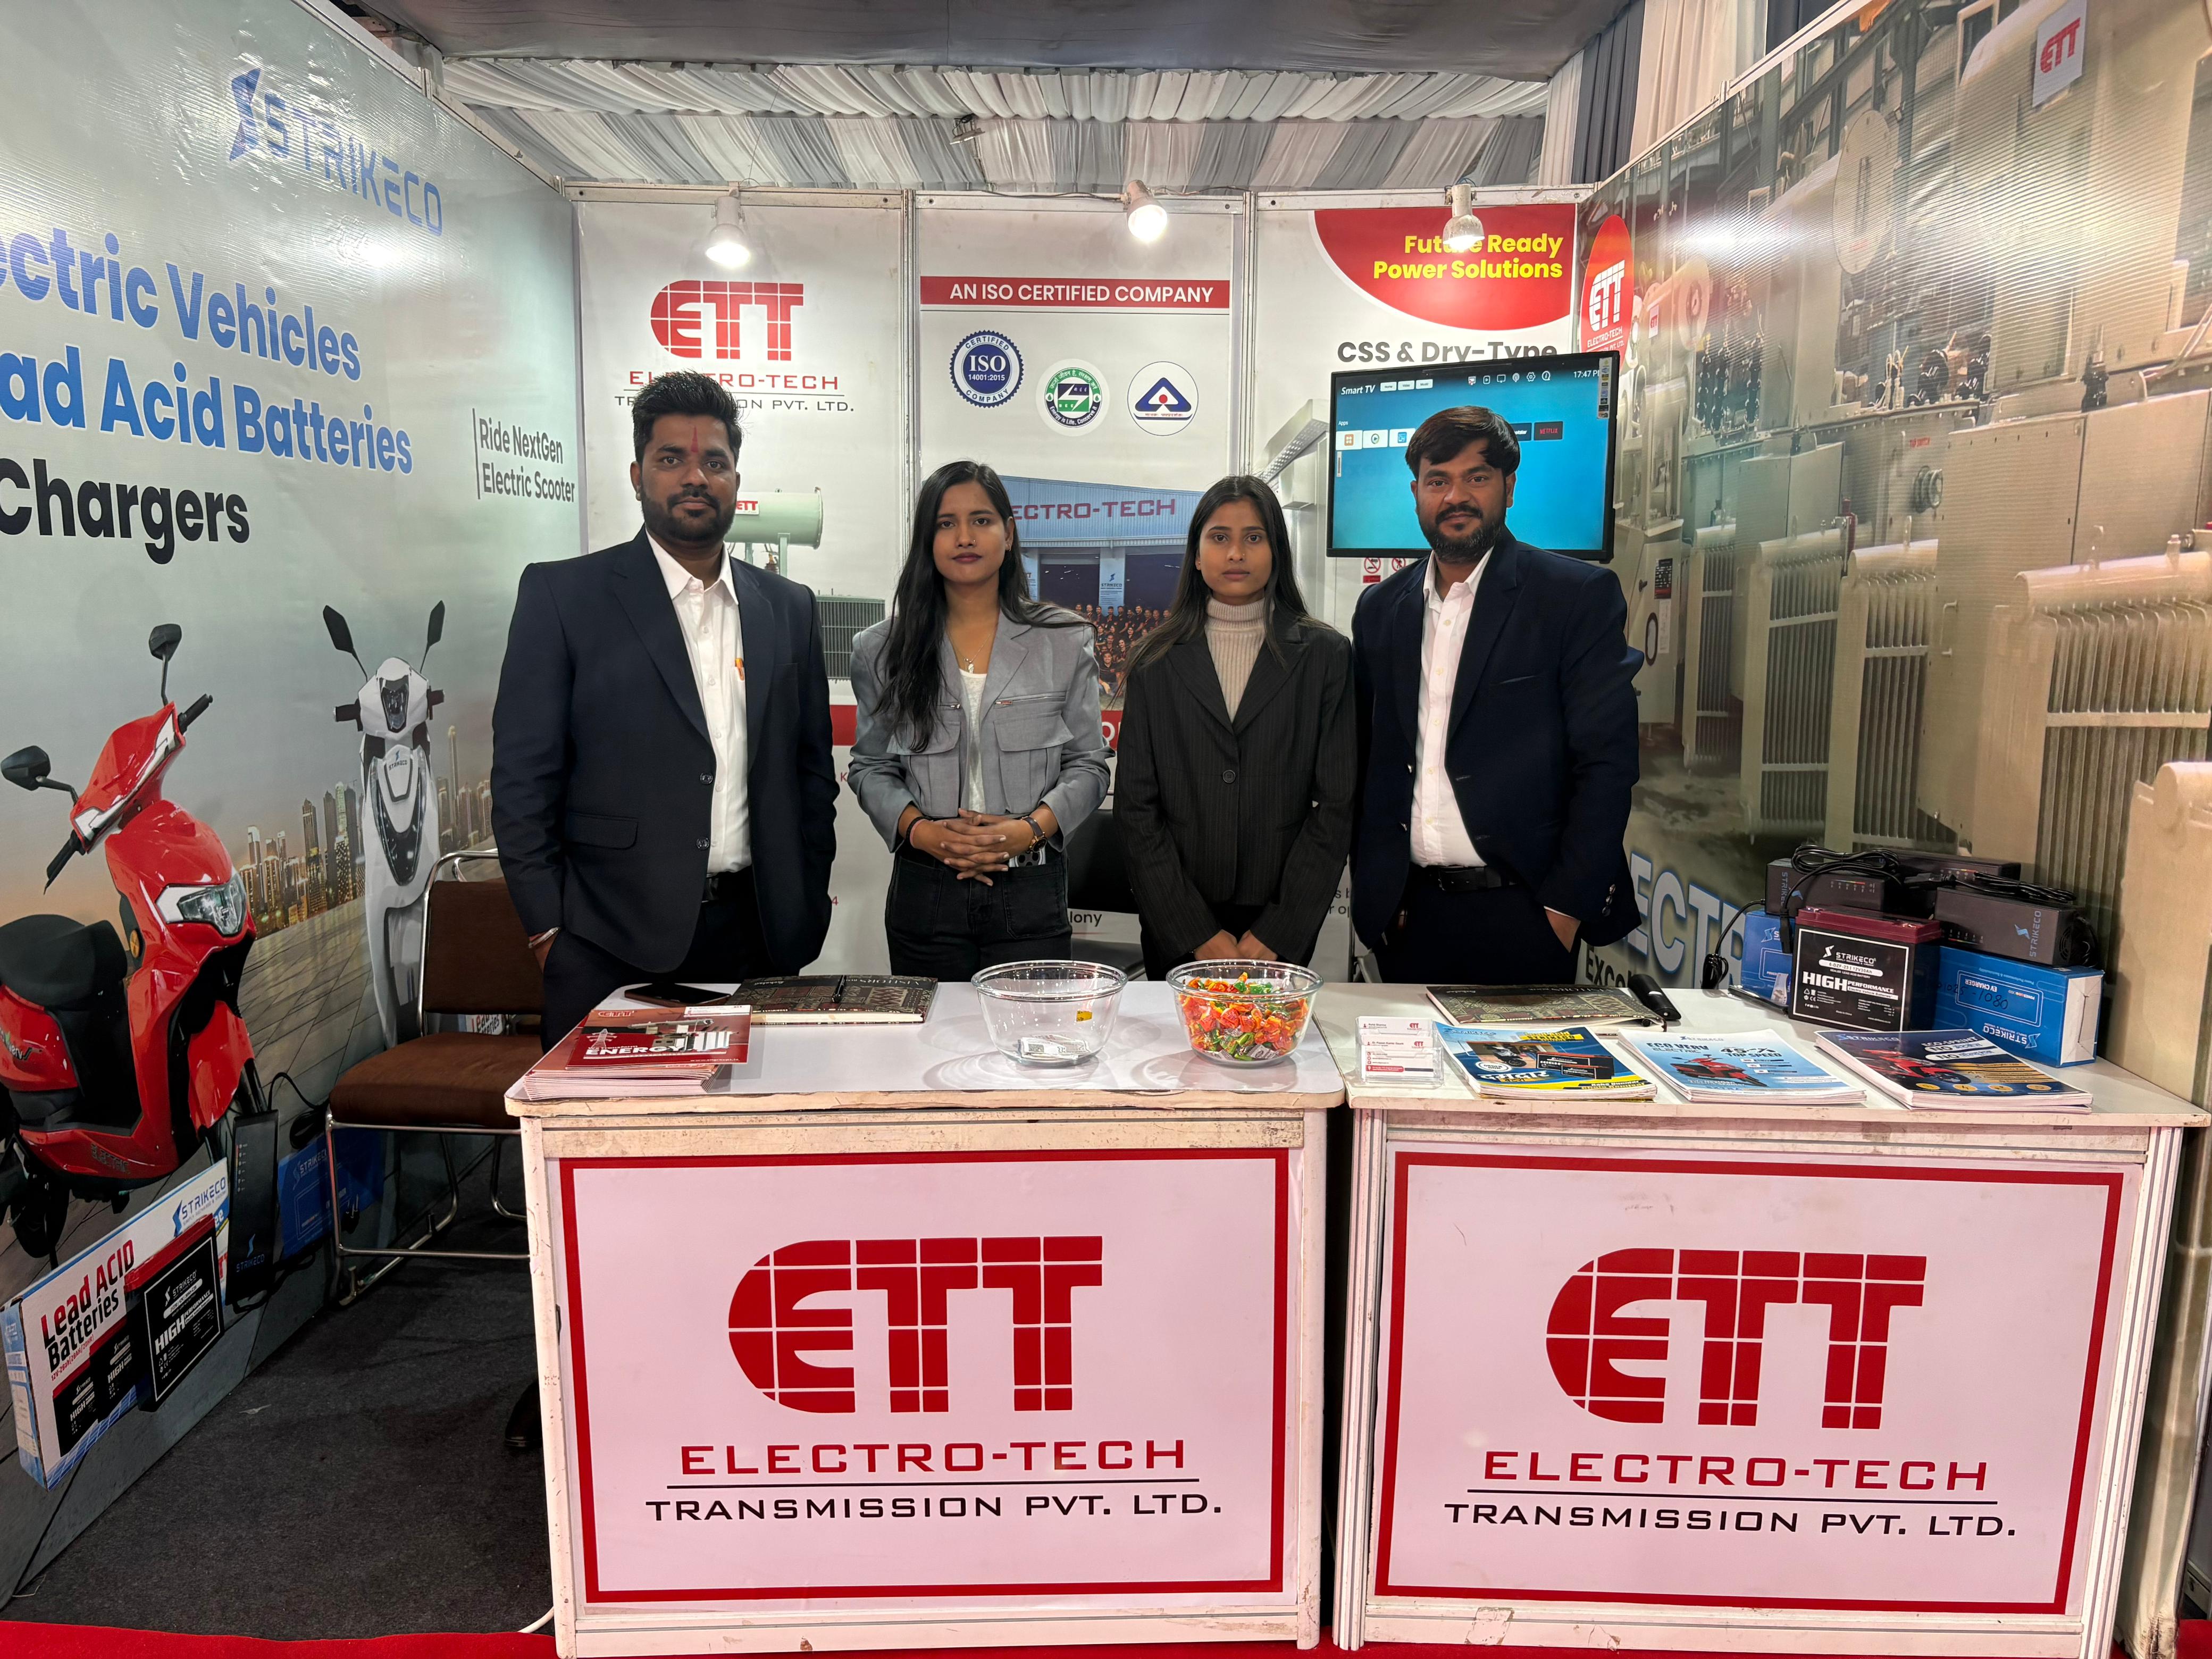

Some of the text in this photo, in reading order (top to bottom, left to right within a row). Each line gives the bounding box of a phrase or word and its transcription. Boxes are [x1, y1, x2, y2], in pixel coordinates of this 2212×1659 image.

[2040, 17, 2081, 74] ETT
[263, 92, 443, 236] STRIKECO
[1405, 235, 1563, 258] Fute Ready
[1373, 258, 1562, 279] Power Solutions
[0, 228, 360, 381] ctric Vehicles
[950, 284, 1213, 303] AN ISO CERTIFIED COMPANY
[1588, 259, 1625, 332] ETT
[650, 280, 803, 361] ETT
[965, 336, 1009, 351] CERTIFIED
[1587, 326, 1622, 348] ELECTRO-TECH
[969, 355, 1006, 372] ISO
[1337, 341, 1557, 364] CSS & Dry-Type
[630, 371, 839, 390] ELRO-TECH
[1341, 384, 1376, 396] Smart TV
[773, 400, 808, 410] PVT.
[817, 401, 854, 412] LTD.
[966, 388, 1009, 403] COMPANY
[1, 345, 413, 475] ad Acid Batteries
[479, 417, 563, 465] Ride NextGen
[482, 462, 575, 503] Electric Scooter
[0, 458, 249, 565] Chargers
[2029, 910, 2042, 957] STRIKECO
[1836, 952, 1874, 964] STRIKECO
[1803, 971, 1894, 994] HIGH PERFORMANCE
[1965, 978, 1990, 991] CHARGER
[1983, 1025, 2027, 1045] STRIKECO
[585, 1045, 685, 1055] ENERGY
[1477, 1070, 1550, 1080] दमदार
[181, 1176, 227, 1220] STRIKECO
[237, 1253, 265, 1272] STRIKECO
[40, 1273, 91, 1350] Lead
[96, 1239, 135, 1299] ACID
[172, 1270, 197, 1296] STRIKECO
[47, 1288, 120, 1373] Batteries
[154, 1313, 186, 1355] HIGH
[728, 1236, 1102, 1413] ETT
[1546, 1247, 1927, 1430] ETT
[107, 1360, 124, 1384] HIGH
[681, 1439, 1184, 1476] ELECTRO-TECH
[1484, 1451, 1987, 1492] ELECTRO-TECH
[646, 1494, 1222, 1521] TRANSMISSION PVT. LTD.
[1444, 1503, 2017, 1538] TRANSMISSION PVT. LTD.
